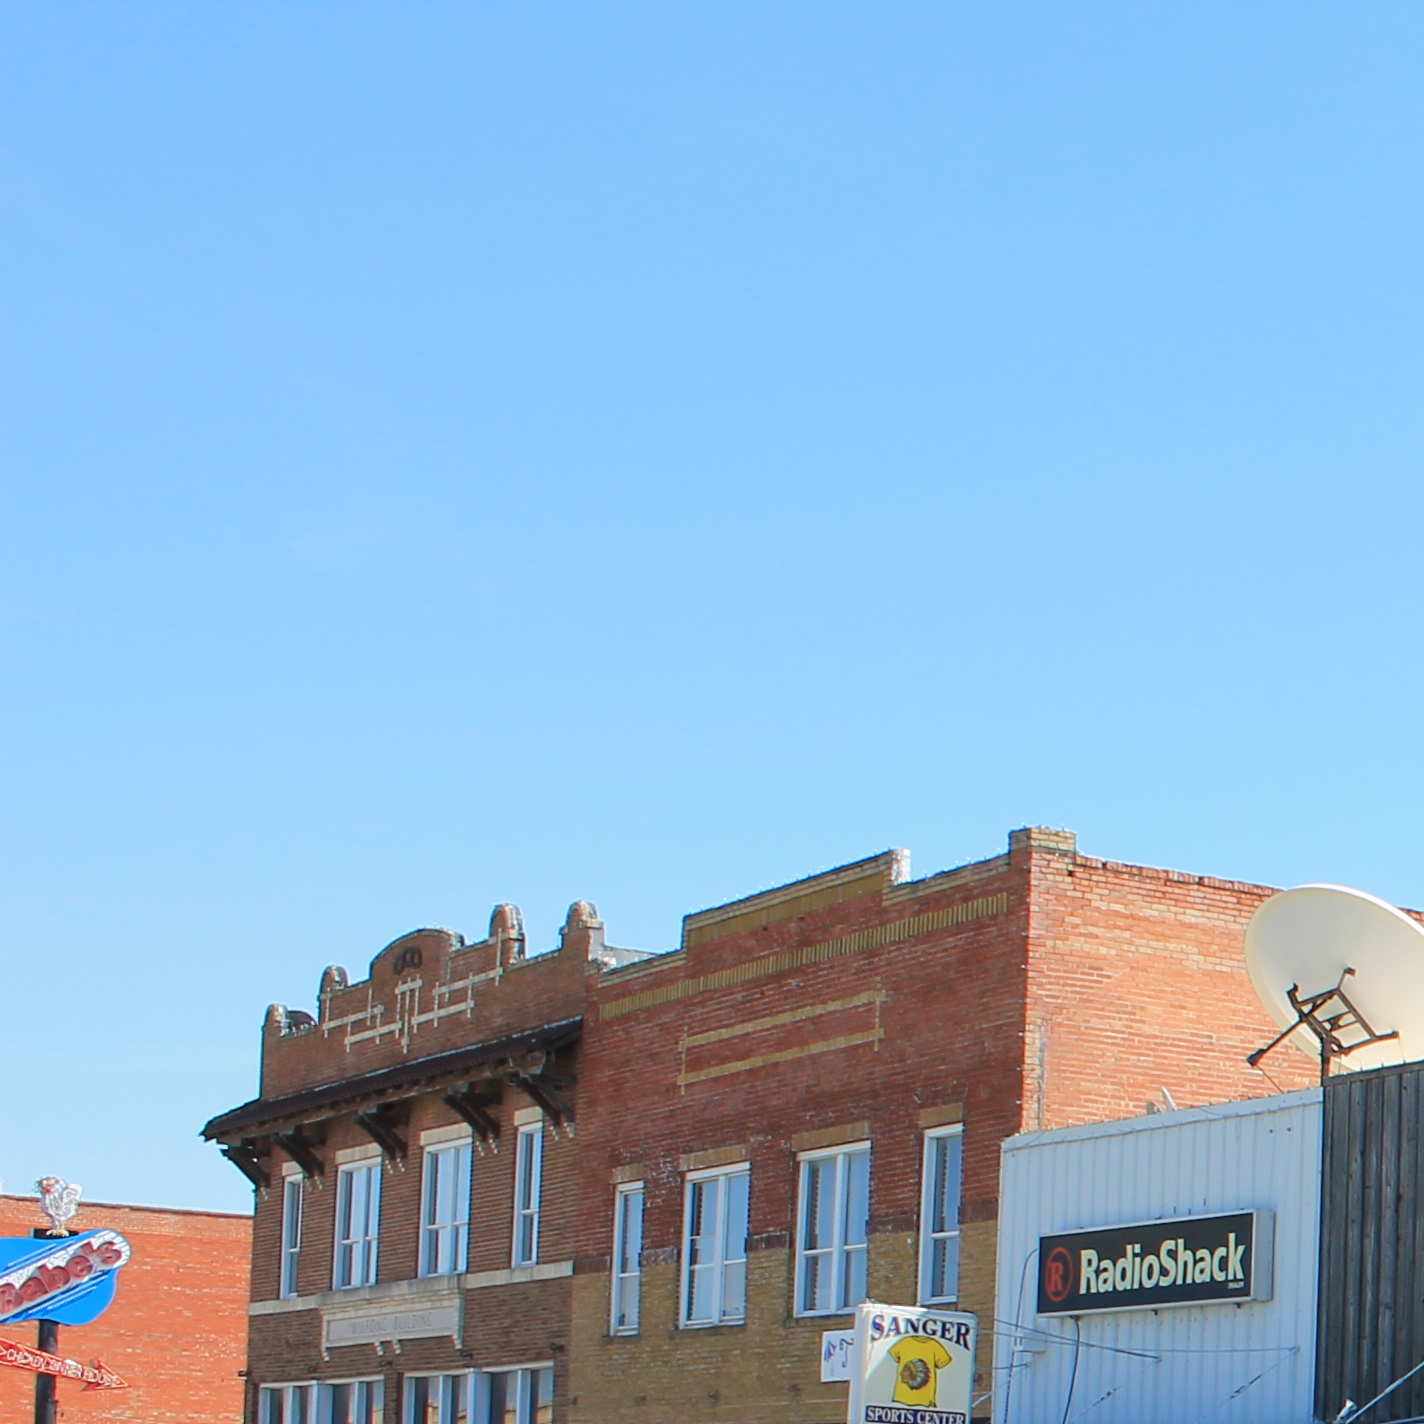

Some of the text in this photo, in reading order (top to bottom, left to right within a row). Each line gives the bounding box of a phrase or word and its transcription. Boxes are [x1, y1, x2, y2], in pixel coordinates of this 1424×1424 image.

[1079, 1233, 1246, 1295] RadioShack
[871, 1314, 971, 1351] SANGER
[6, 1349, 46, 1368] CHICKEN
[867, 1407, 914, 1424] SPORTS
